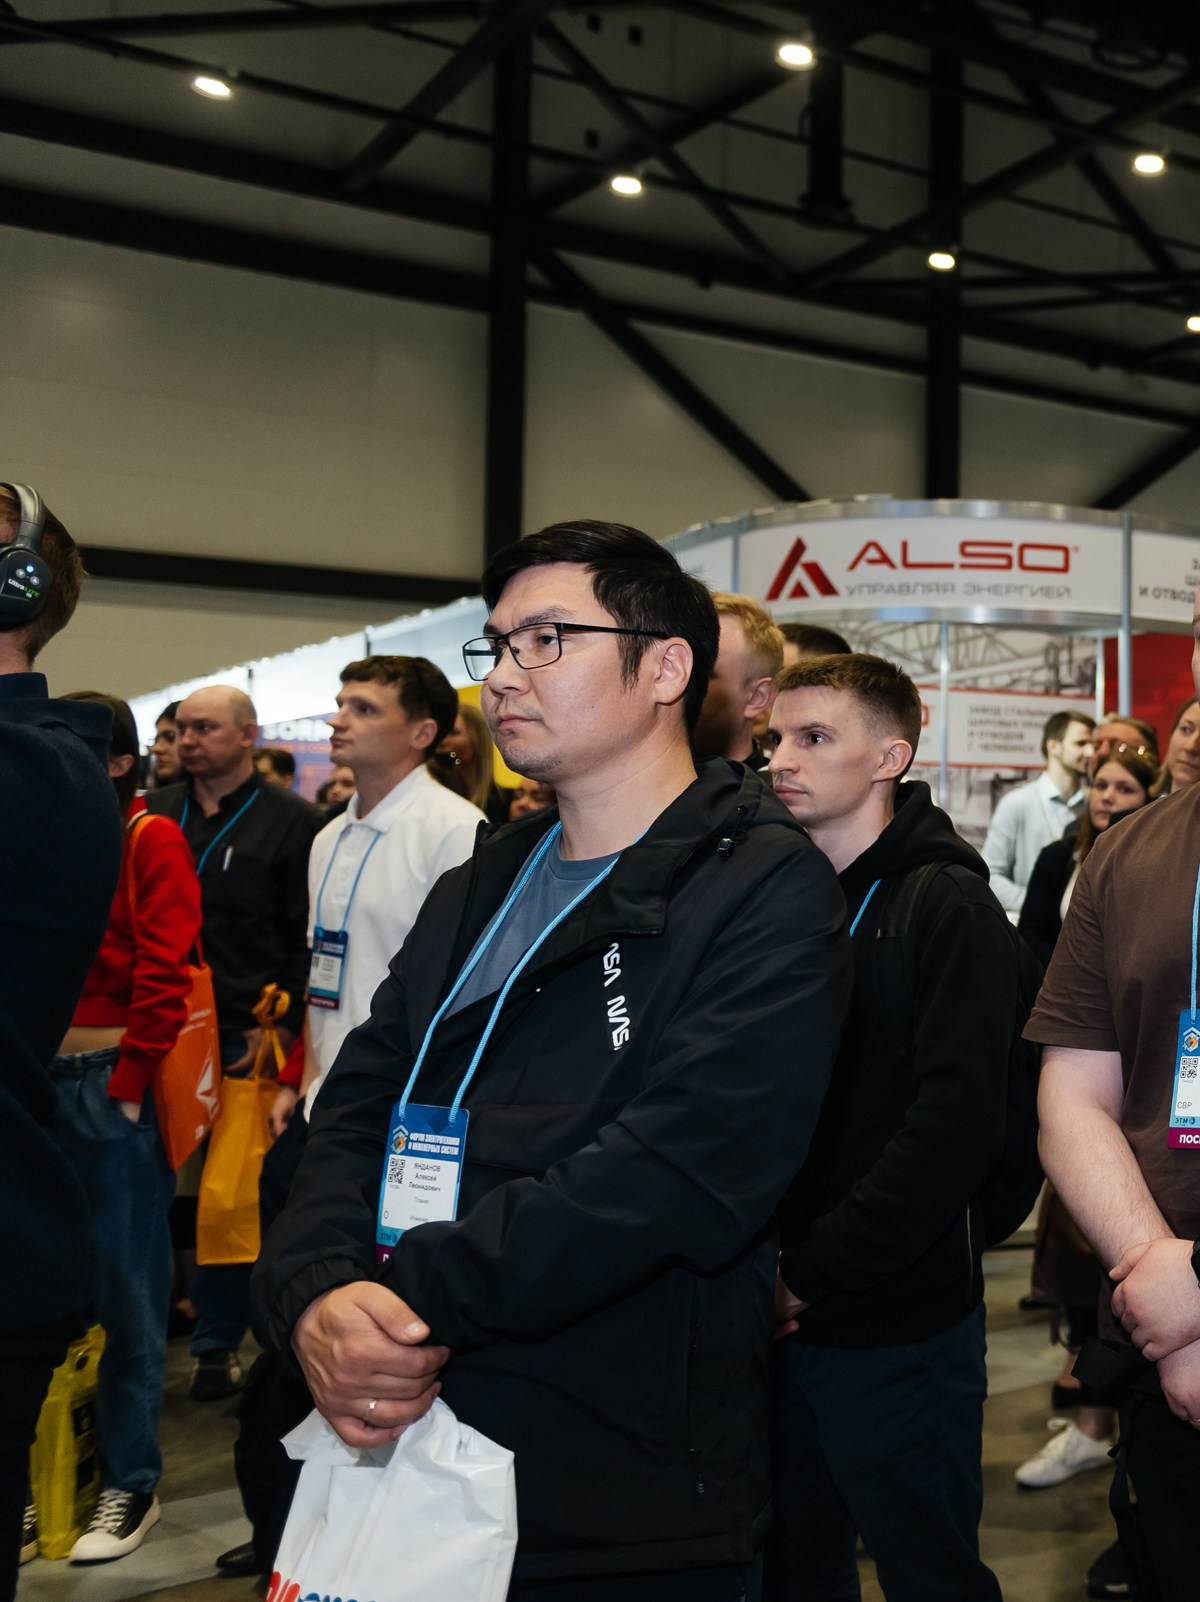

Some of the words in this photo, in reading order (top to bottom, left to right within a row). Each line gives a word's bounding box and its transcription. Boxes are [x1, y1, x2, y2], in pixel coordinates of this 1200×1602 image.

[846, 539, 1070, 574] ALSO
[844, 581, 956, 597] УПРАВЛЯЯ
[962, 582, 1072, 599] ЭНЕРГИЕЙ
[1138, 586, 1148, 598] И
[1151, 587, 1196, 603] ОТВОД
[606, 995, 631, 1051] NAS
[413, 1162, 441, 1173] ЯНДАНОВ
[414, 1172, 437, 1182] Алексей
[408, 1181, 441, 1192] Леонидович
